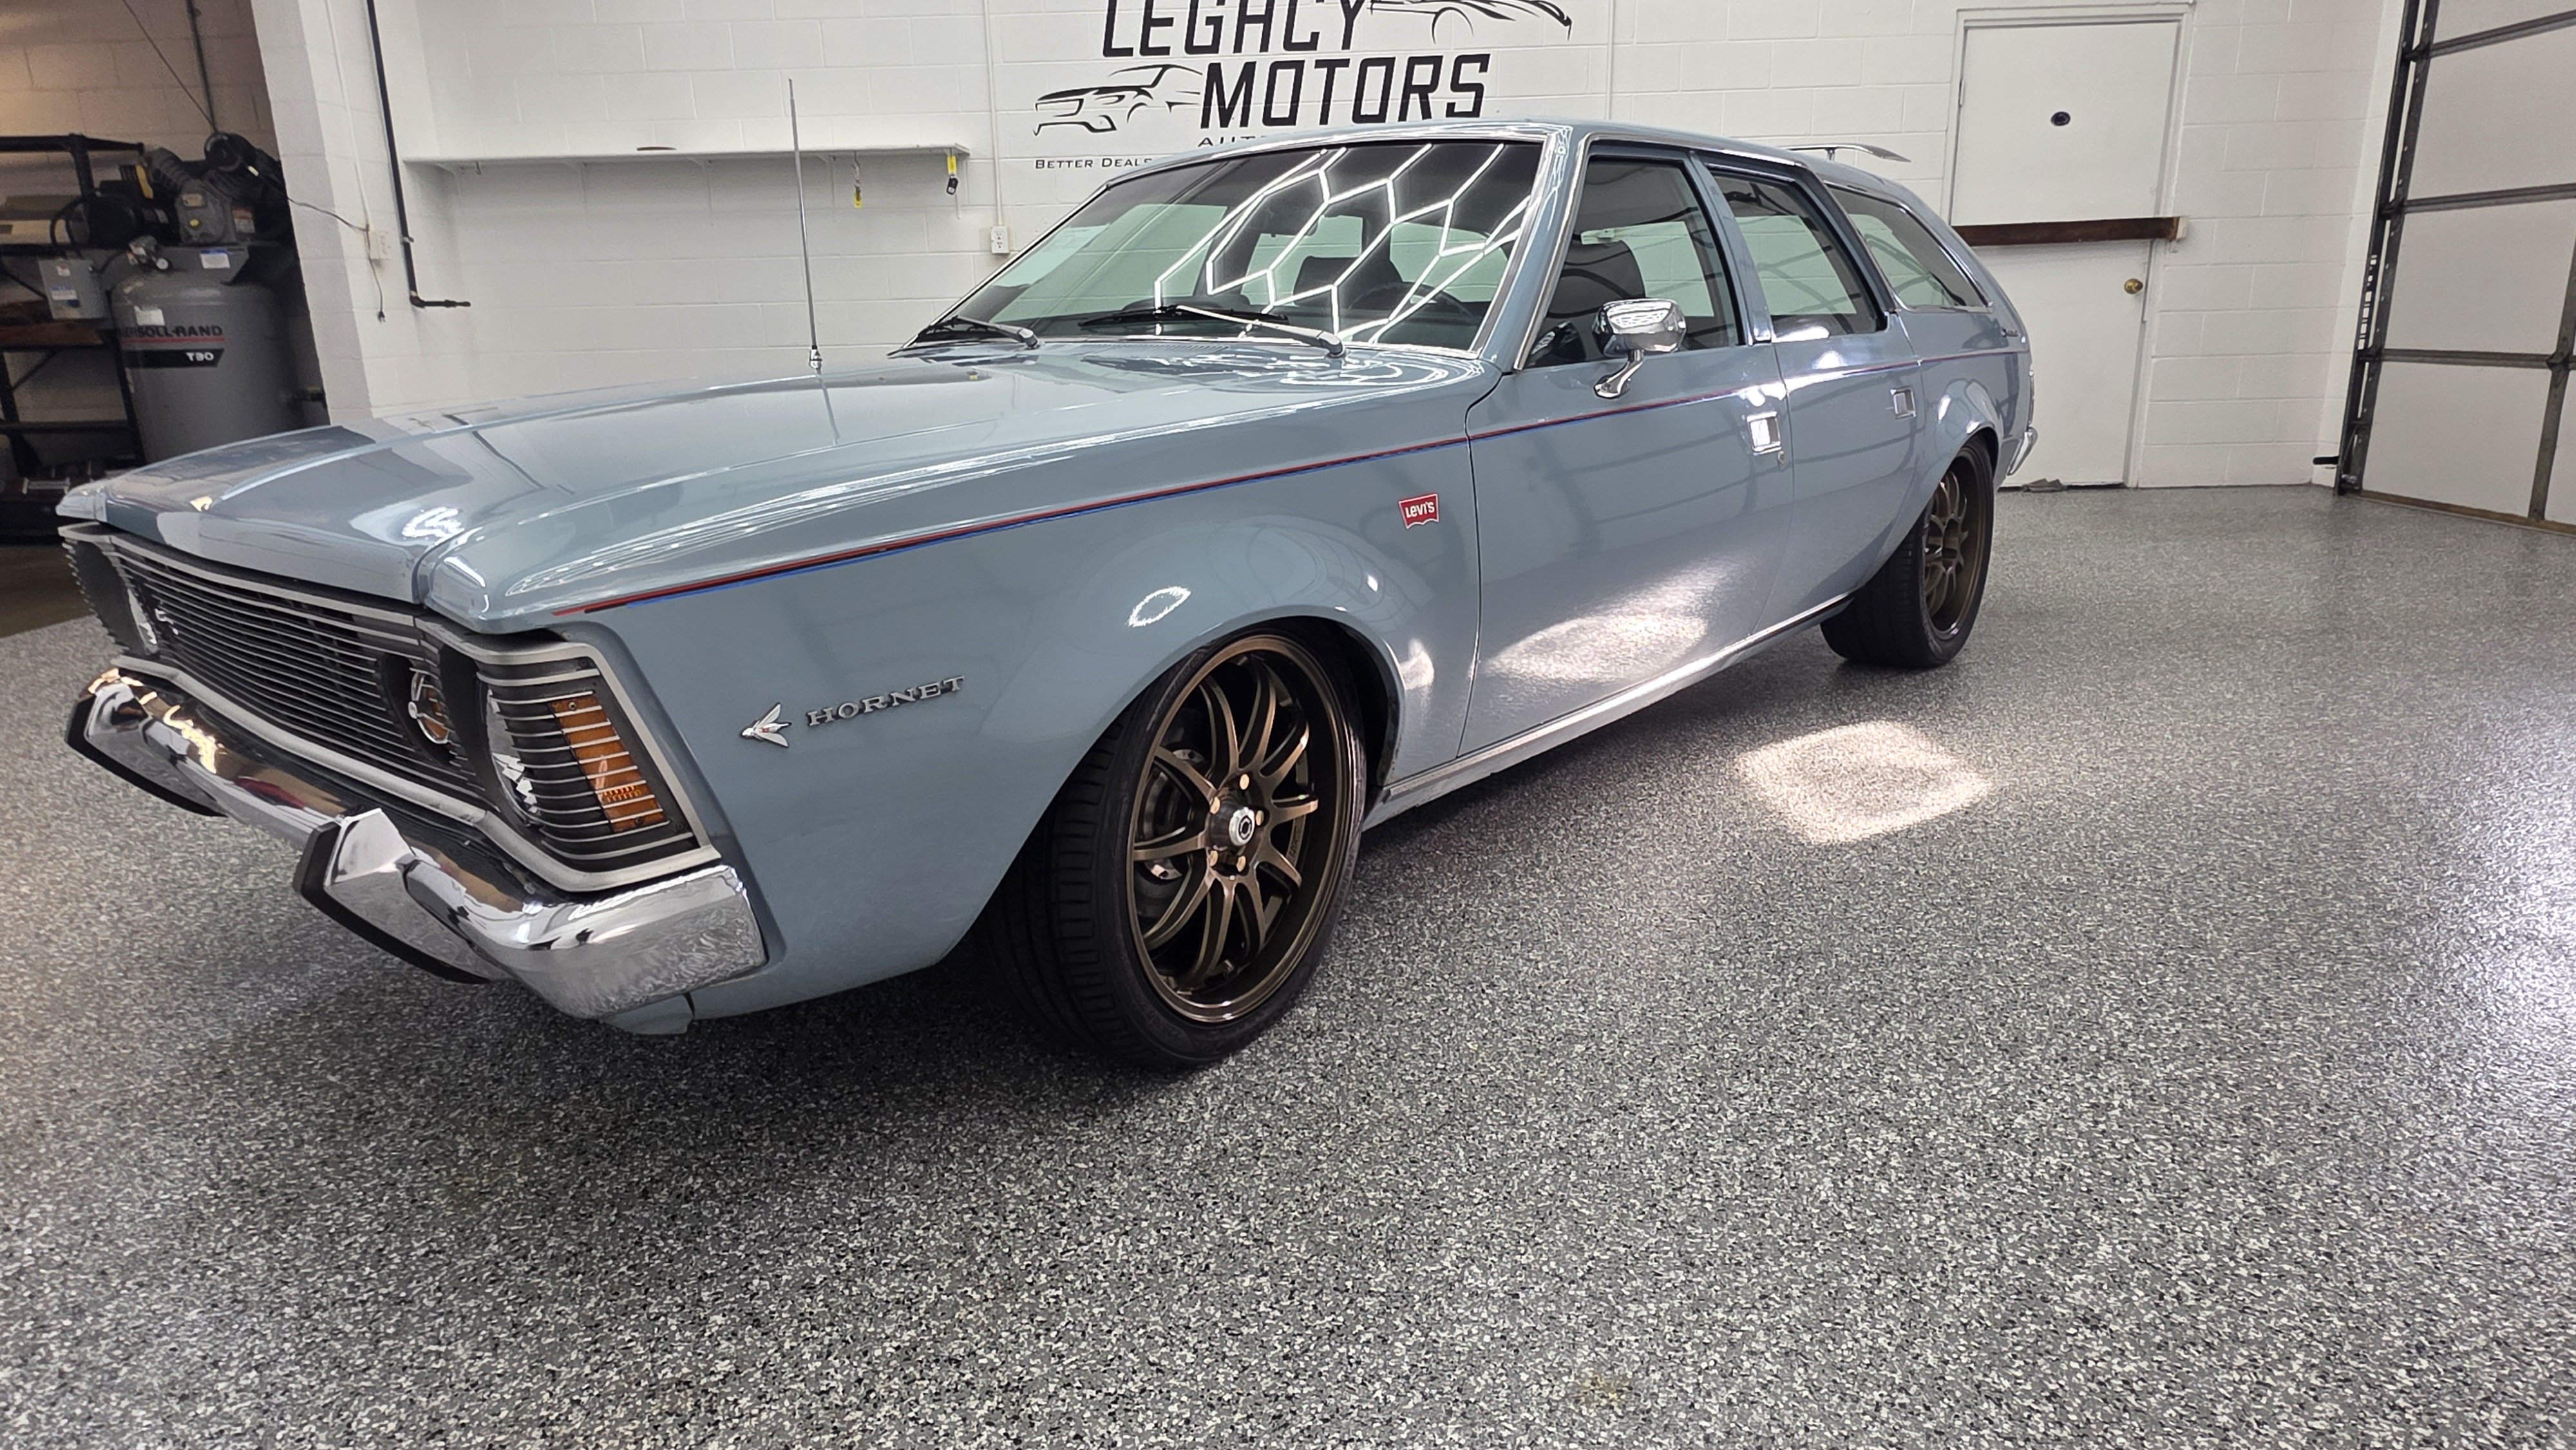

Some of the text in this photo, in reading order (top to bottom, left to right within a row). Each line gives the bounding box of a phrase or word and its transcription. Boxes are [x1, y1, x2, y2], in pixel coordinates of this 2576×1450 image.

[1103, 0, 1365, 57] LEGACY
[1200, 53, 1491, 129] MOTORS
[807, 675, 965, 726] HORNET
